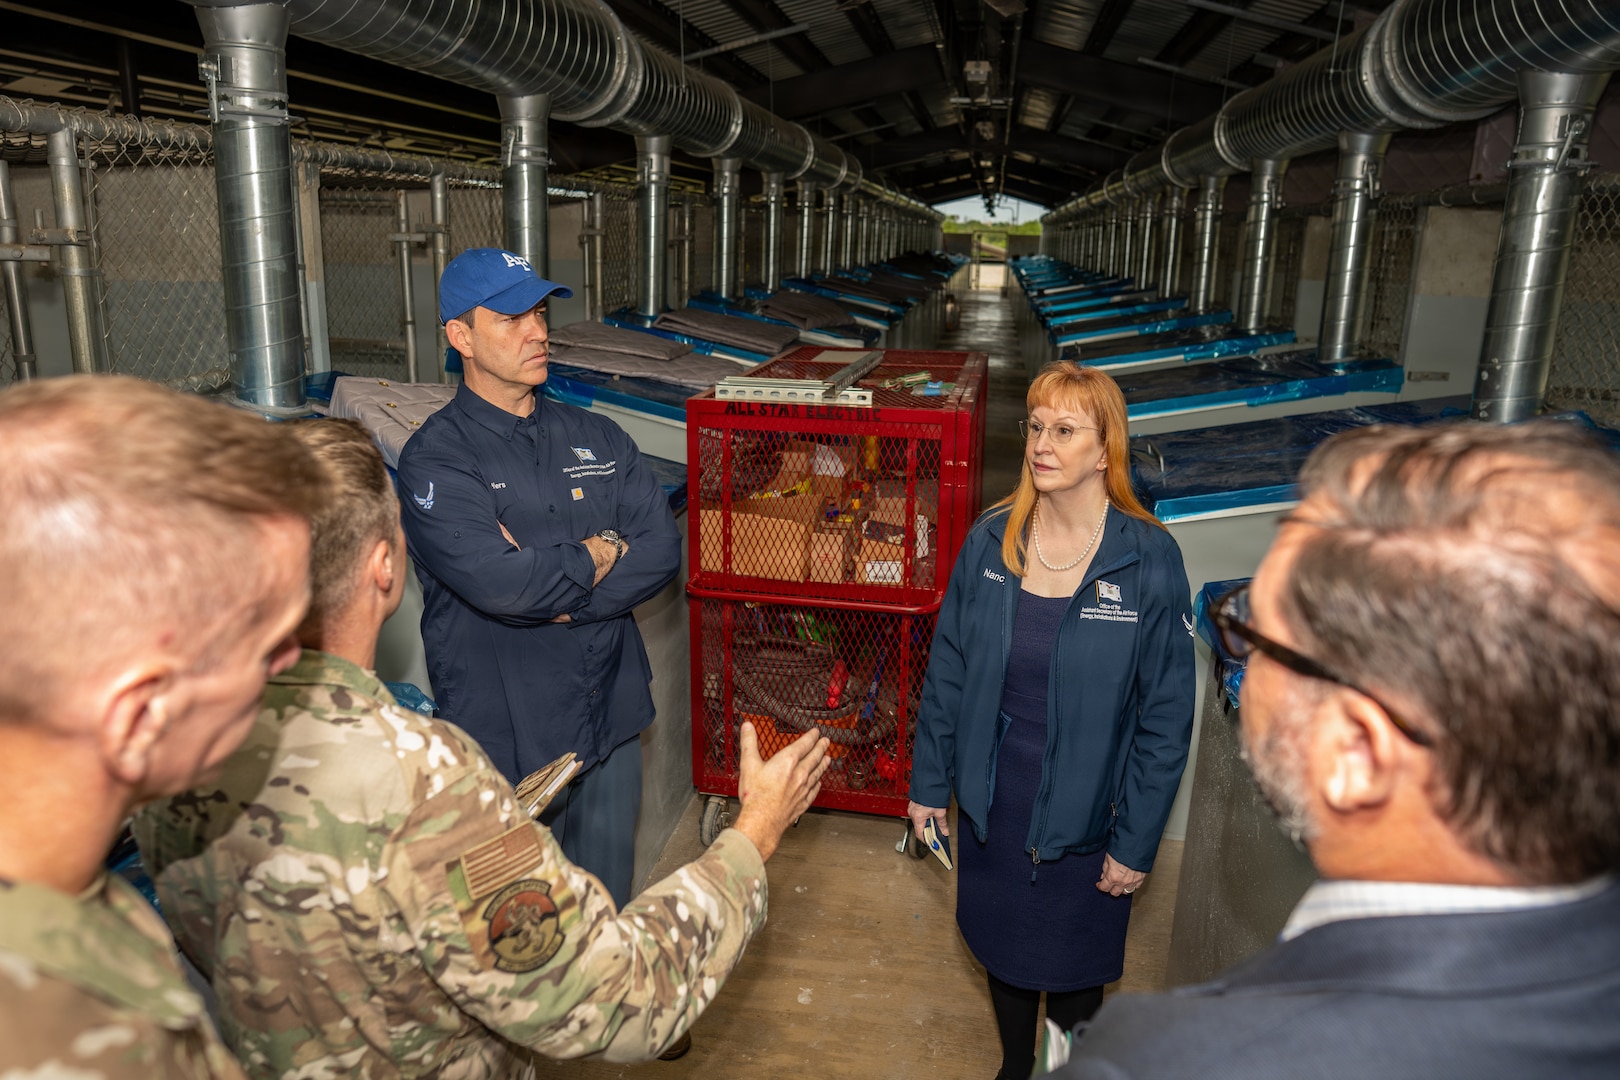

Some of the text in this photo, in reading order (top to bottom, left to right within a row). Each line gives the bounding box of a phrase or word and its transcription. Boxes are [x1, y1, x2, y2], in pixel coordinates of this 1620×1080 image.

[501, 253, 531, 271] AF
[724, 401, 881, 421] ALL STAR ELECTRIC
[983, 568, 1005, 583] Nanc
